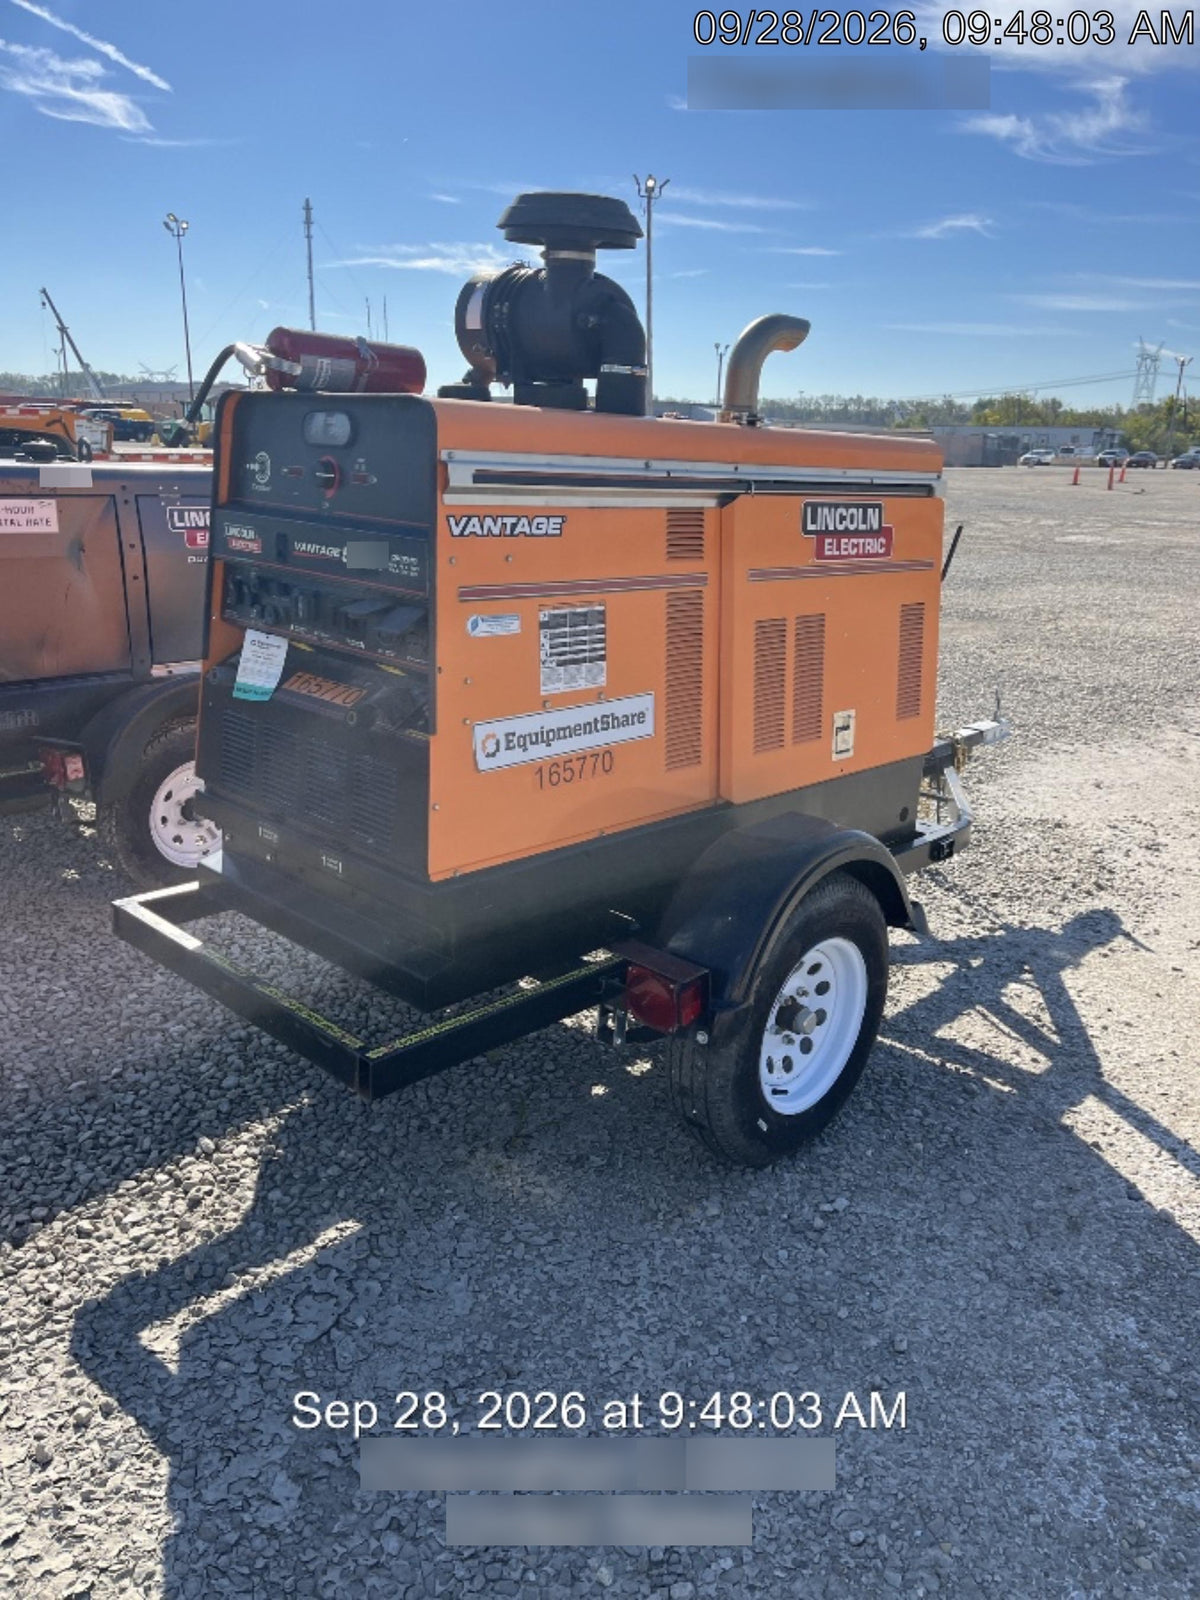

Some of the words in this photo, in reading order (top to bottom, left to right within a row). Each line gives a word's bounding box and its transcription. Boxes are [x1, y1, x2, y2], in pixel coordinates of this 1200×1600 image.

[447, 515, 563, 537] VANTAGE
[806, 506, 879, 531] LINCOLN
[294, 541, 340, 558] VANTAGE
[824, 536, 886, 556] ELECTRIC
[288, 674, 364, 705] 165770
[504, 711, 646, 752] EquipmentShare
[534, 750, 614, 790] 165770
